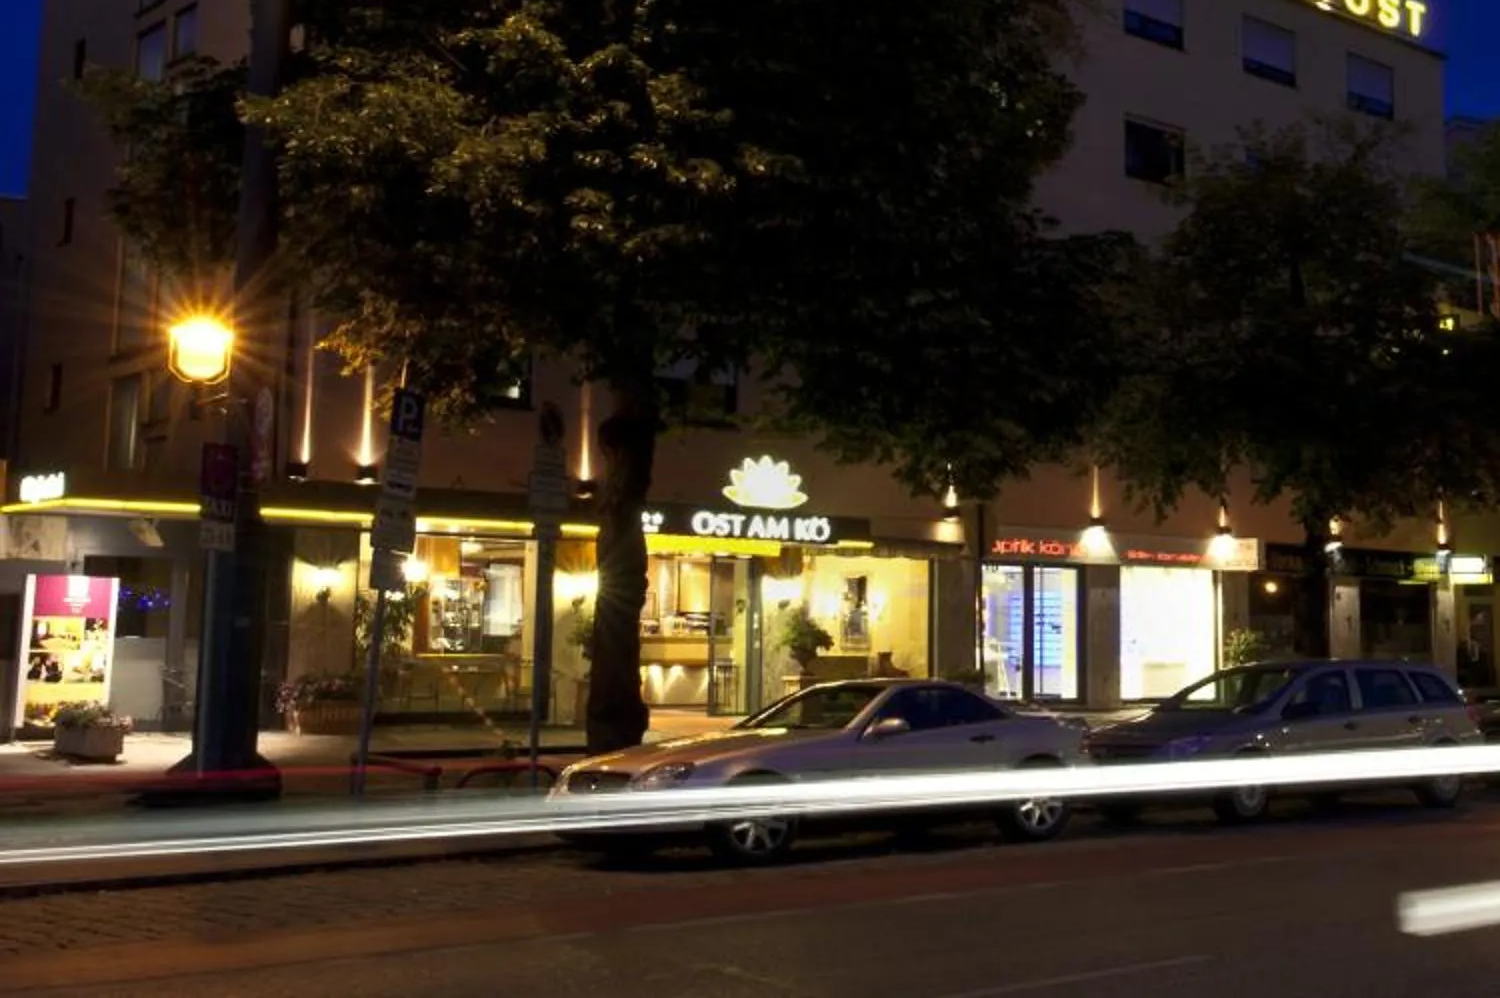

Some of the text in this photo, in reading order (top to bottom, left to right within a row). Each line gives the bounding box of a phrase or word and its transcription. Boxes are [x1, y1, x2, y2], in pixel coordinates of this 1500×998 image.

[691, 510, 746, 536] OST
[747, 514, 789, 540] AM
[793, 515, 831, 542] KÖ
